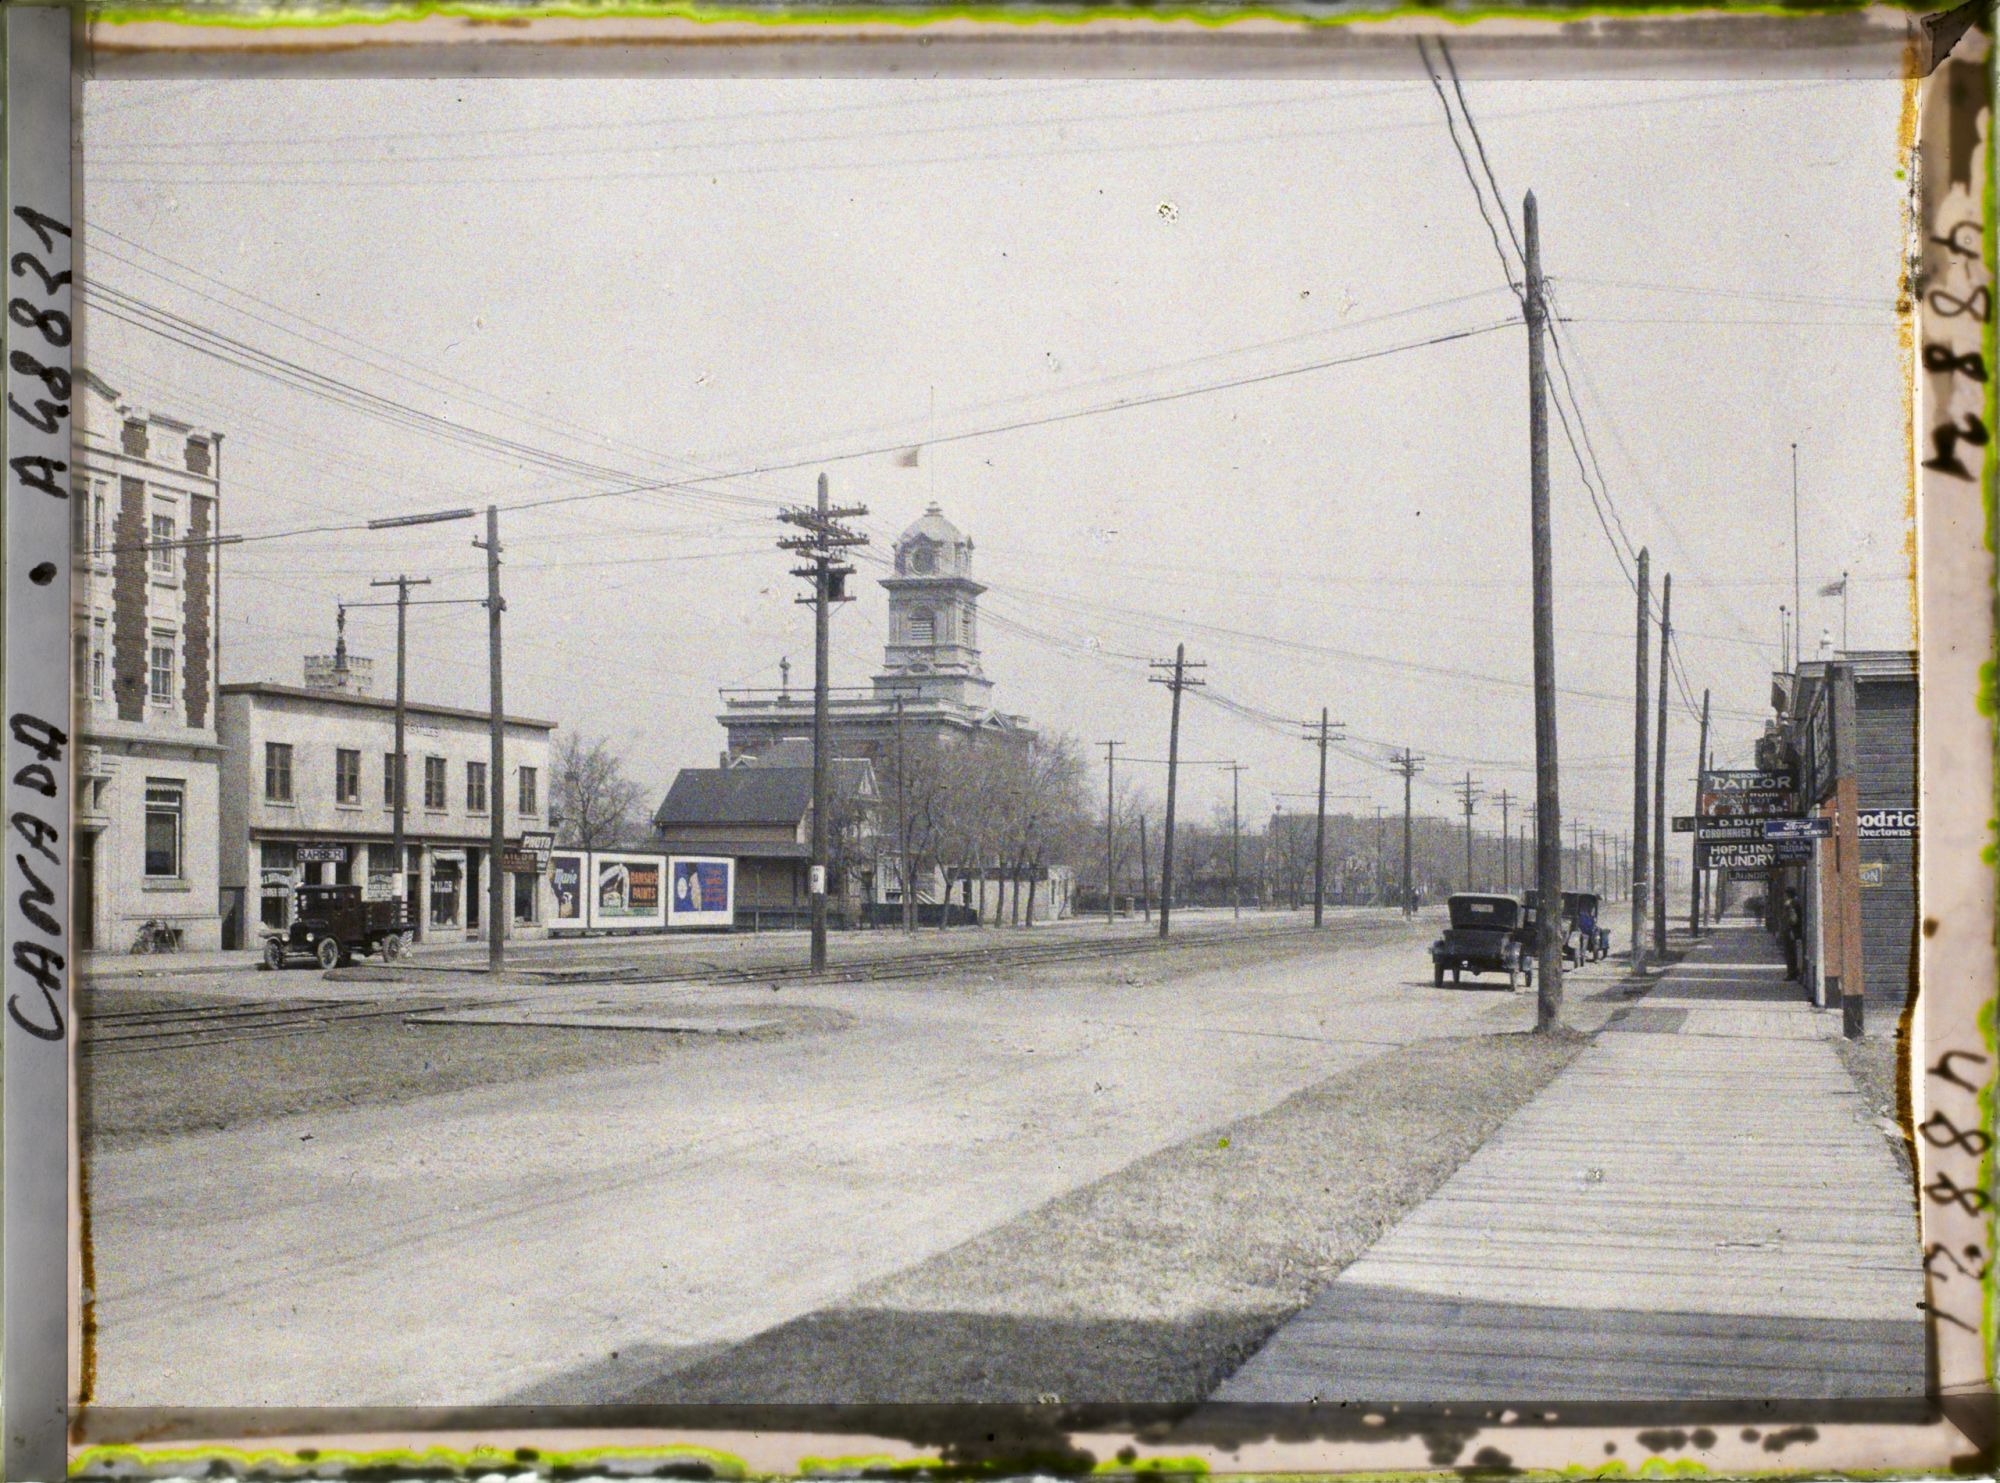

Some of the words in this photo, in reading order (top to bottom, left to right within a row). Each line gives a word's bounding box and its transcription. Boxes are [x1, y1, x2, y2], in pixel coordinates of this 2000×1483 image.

[1709, 775, 1792, 790] TAILOR
[1835, 811, 1920, 827] odric
[1783, 821, 1812, 831] Ford
[523, 836, 551, 849] PHOTO
[299, 850, 342, 860] BARBER
[1709, 854, 1776, 867] LAUNDRY
[8, 712, 68, 1041] CANADA
